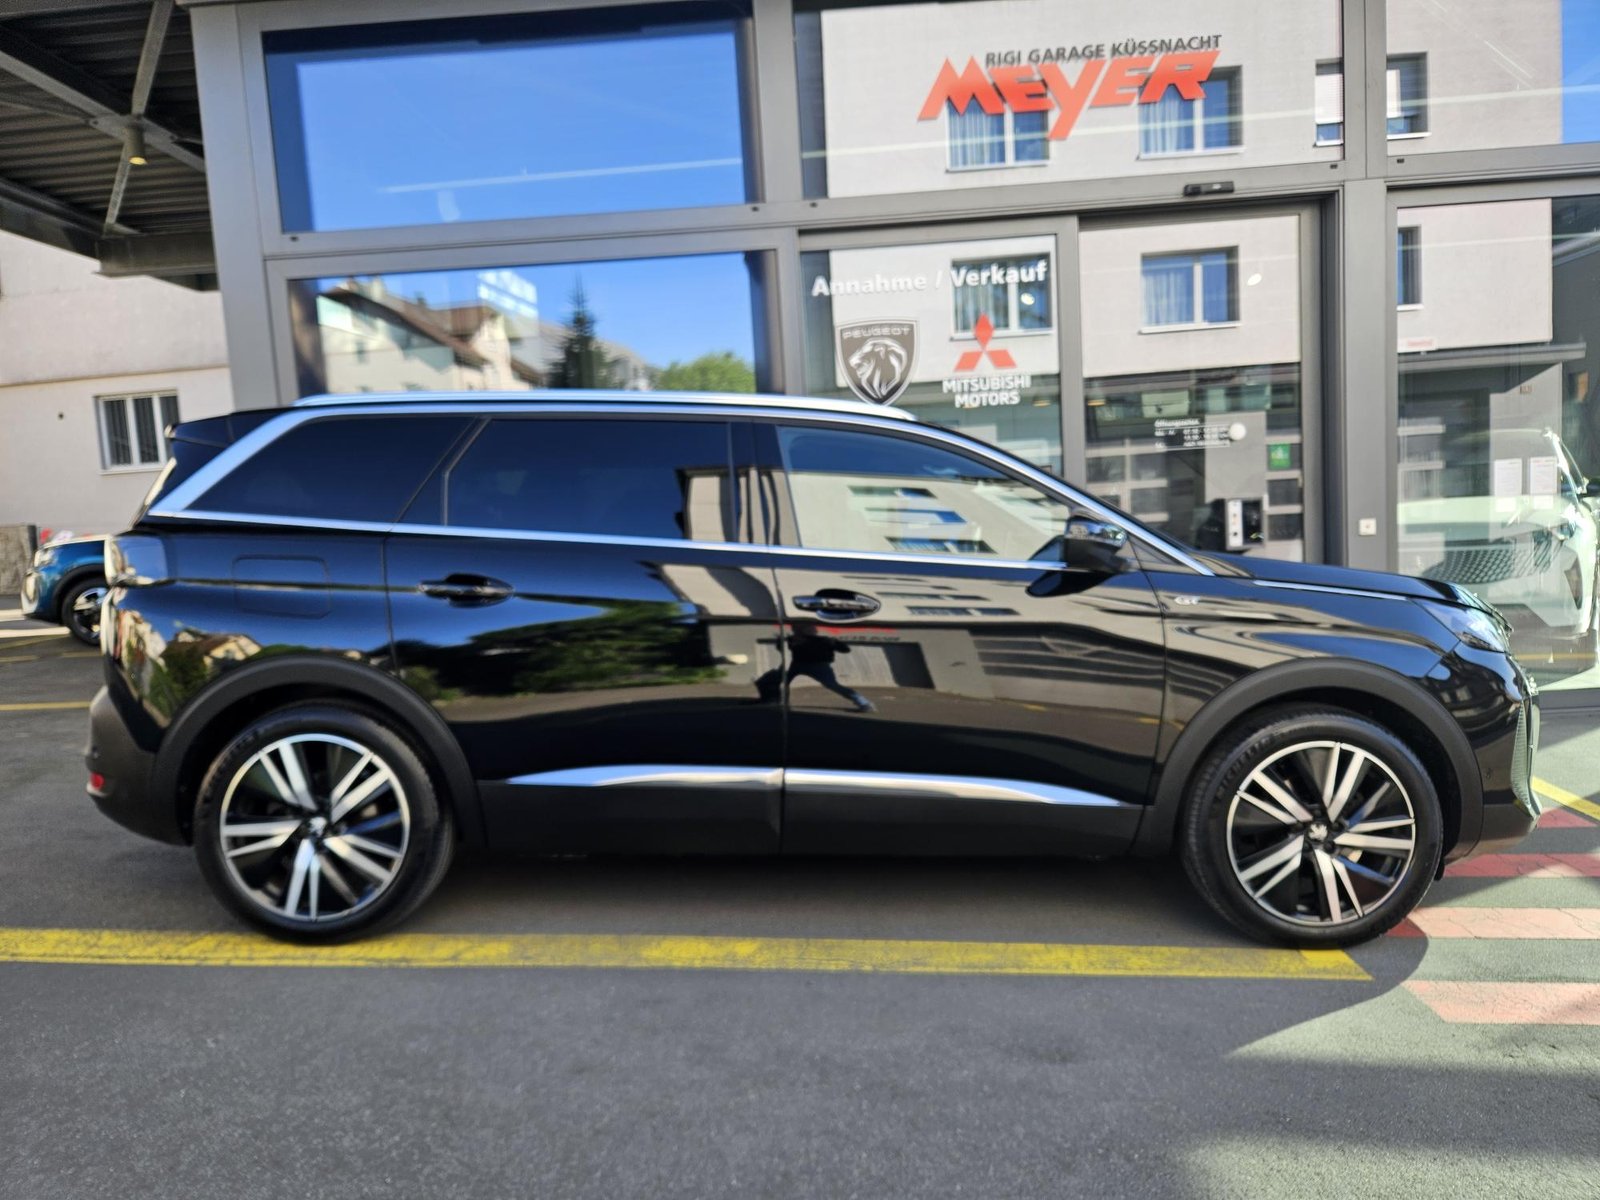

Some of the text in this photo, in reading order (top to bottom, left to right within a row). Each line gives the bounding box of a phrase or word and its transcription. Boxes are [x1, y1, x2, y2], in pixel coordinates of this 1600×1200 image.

[985, 34, 1222, 67] RIGI GARAGE KÜSSNACHT
[917, 49, 1221, 141] MEYER
[811, 273, 927, 297] Annahme
[950, 259, 1048, 287] Verkauf
[842, 327, 912, 339] PEUGEOT
[942, 375, 1032, 394] MITSUBISHI
[954, 390, 1021, 409] MOTORS
